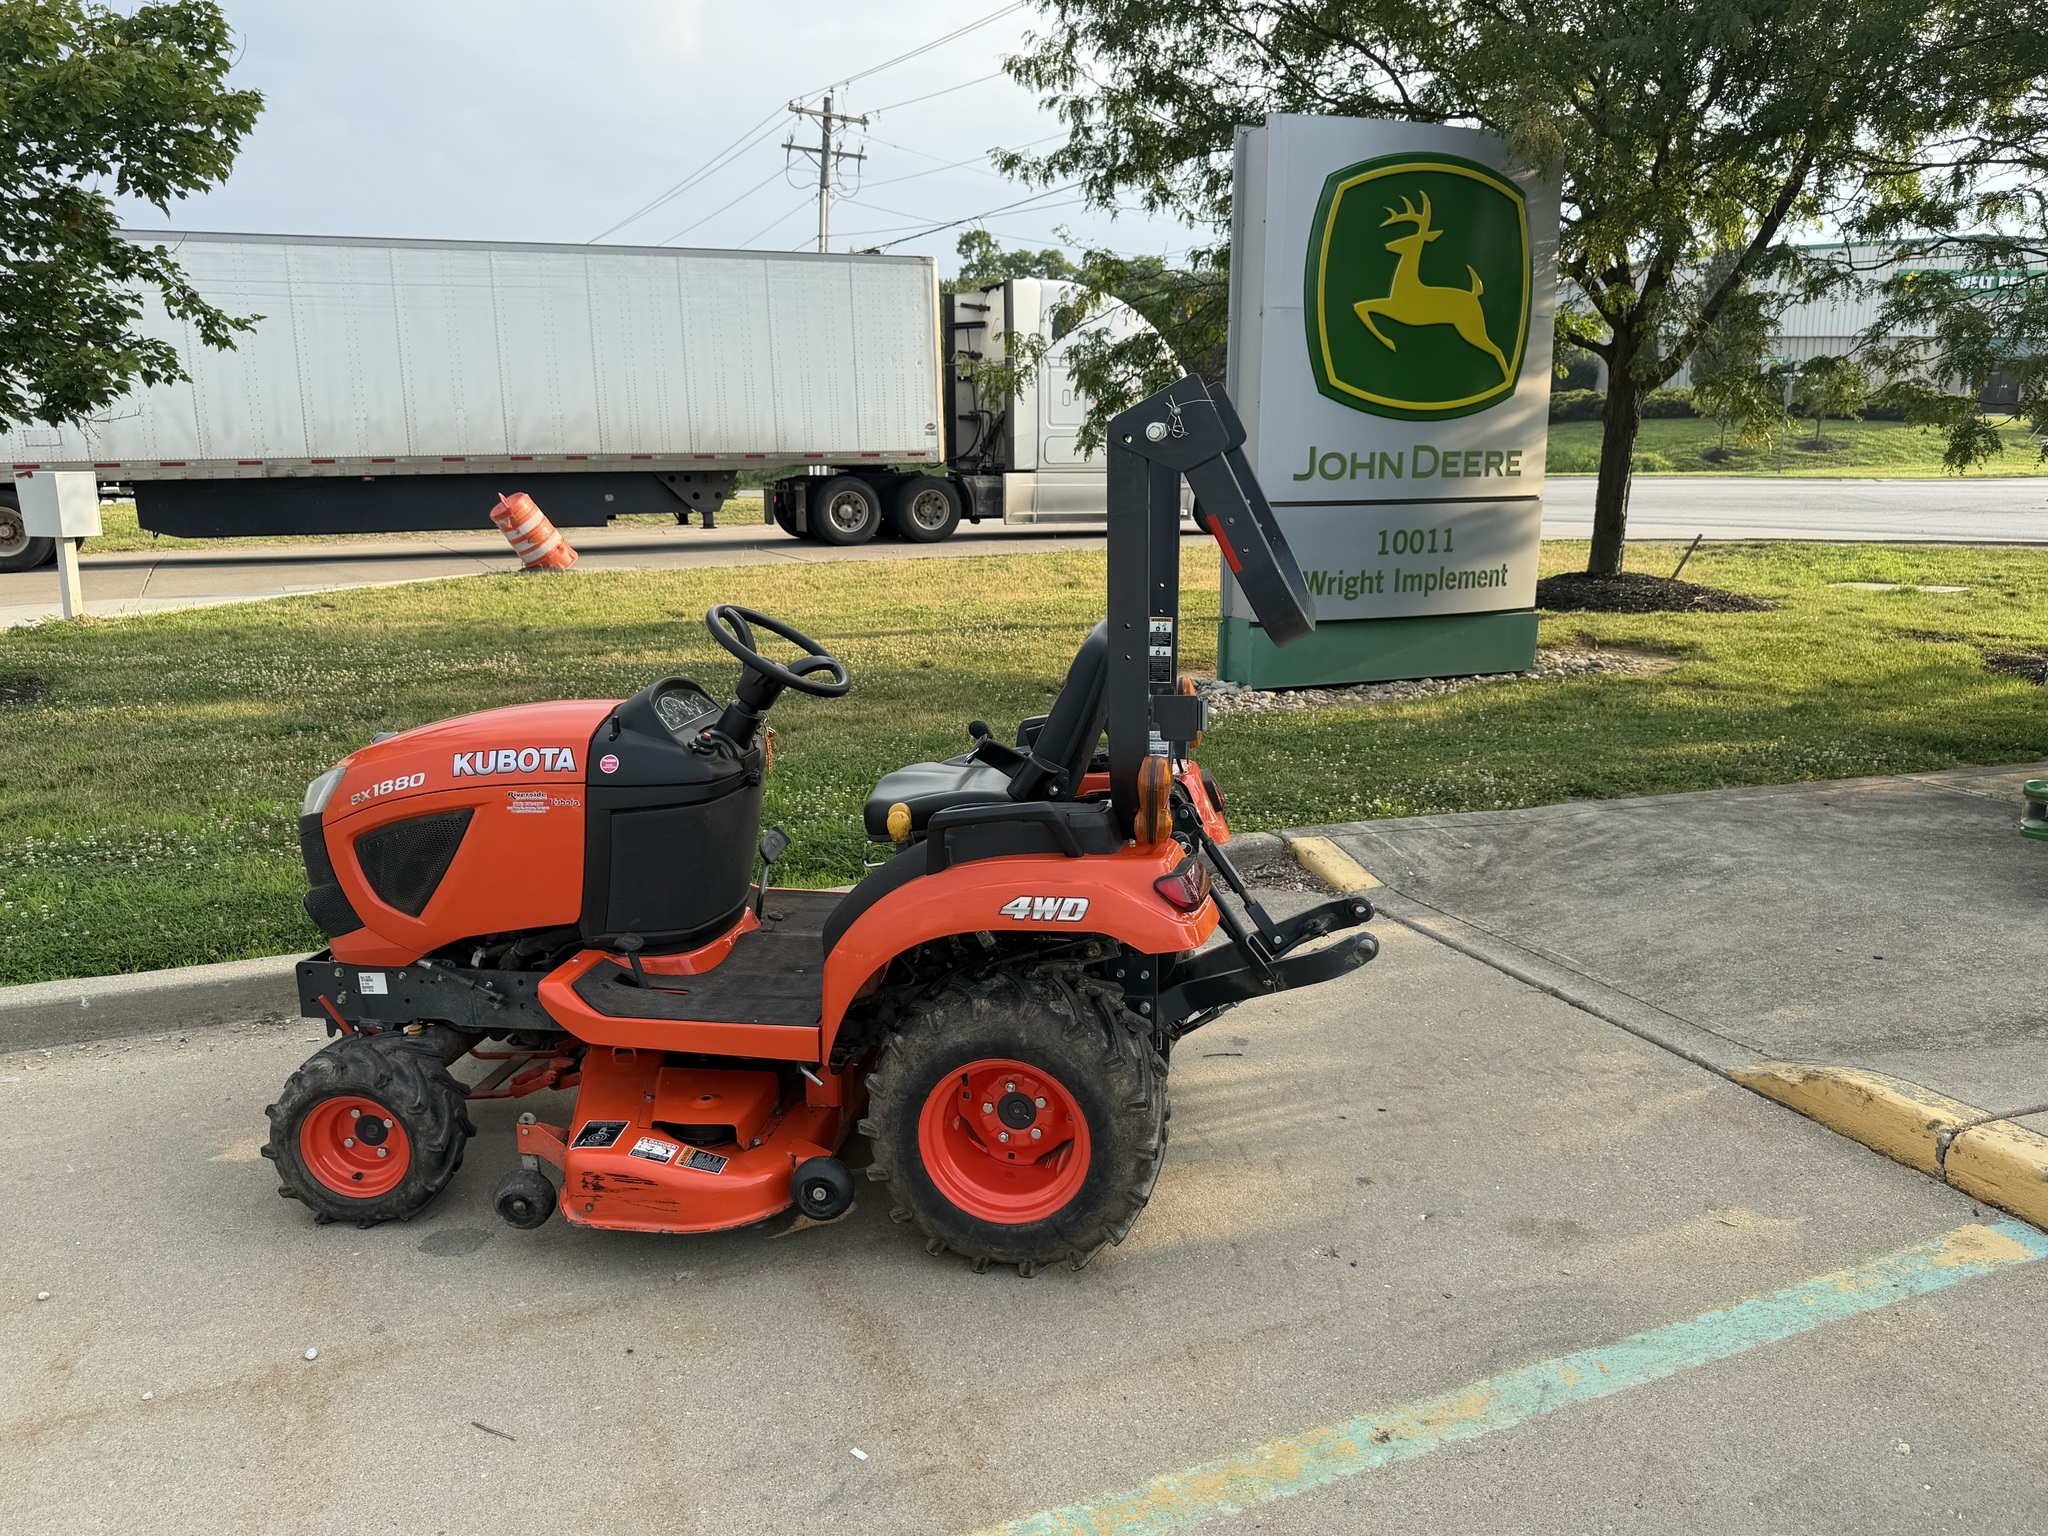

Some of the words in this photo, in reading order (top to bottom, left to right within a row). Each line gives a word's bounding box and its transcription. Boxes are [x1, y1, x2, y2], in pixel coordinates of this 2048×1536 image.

[1292, 445, 1405, 481] JOHN
[1411, 444, 1523, 479] DEERE
[1377, 527, 1454, 556] 10011
[1303, 568, 1385, 601] Wright
[1393, 562, 1509, 597] Implement
[452, 746, 578, 777] KUBOTA
[350, 772, 426, 806] BX1880
[507, 790, 548, 800] Riverside
[549, 797, 580, 806] Kubota
[999, 895, 1090, 922] 4WD
